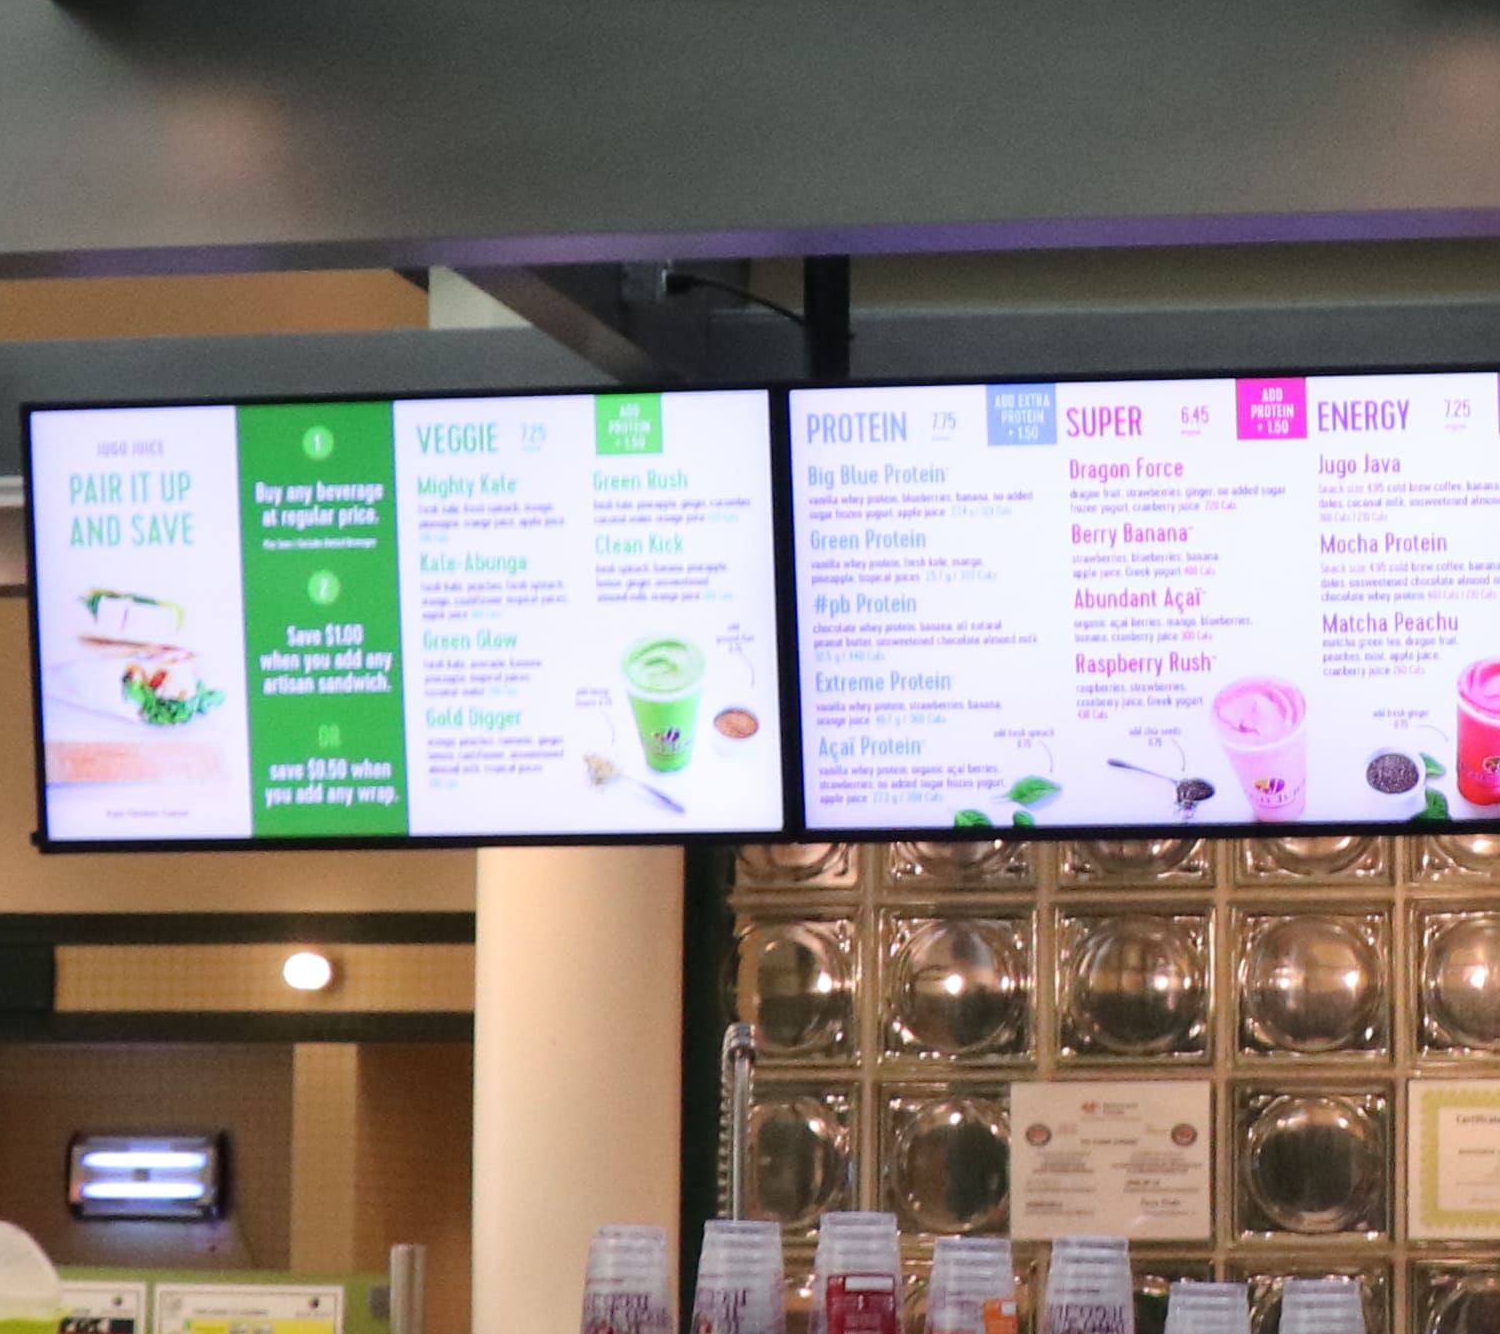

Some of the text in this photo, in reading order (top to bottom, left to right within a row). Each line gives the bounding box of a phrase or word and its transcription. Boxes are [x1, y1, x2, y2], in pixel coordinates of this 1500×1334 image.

[1262, 388, 1283, 402] ADD
[1066, 406, 1209, 437] SUPER 6.45
[1251, 404, 1294, 418] PROTEIN
[1318, 399, 1471, 432] ENERGY 7.25
[416, 424, 498, 455] VEGGIE
[807, 411, 956, 444] PROTEIN 7.75
[808, 463, 946, 490] Big Blue Protein
[1070, 457, 1183, 483] Dragon Force
[1318, 453, 1401, 478] Jugo Java
[70, 471, 191, 504] PAIR IT UP
[418, 475, 516, 499] Mighty Kale
[593, 469, 688, 491] Green Rush
[255, 481, 383, 505] Buy any beverage
[262, 505, 379, 530] at regular price.
[70, 514, 194, 546] AND SAVE
[810, 528, 926, 549] Green Protein
[1071, 523, 1188, 547] Berry Banana
[595, 534, 683, 555] Clean Kick
[1320, 532, 1447, 554] Mocha Protein
[815, 593, 917, 617] #pb Protein
[1075, 588, 1156, 609] Abundant
[1323, 612, 1458, 634] Matcha Peachu
[287, 624, 363, 647] Save $1.00
[423, 629, 517, 650] Green Glow
[260, 649, 392, 674] when you add any
[1076, 652, 1211, 677] Raspberry Rush
[263, 669, 391, 693] artisan sandwich.
[815, 671, 951, 692] Extreme Protein
[426, 708, 521, 731] Gold Digger
[861, 736, 921, 755] Protein
[270, 759, 391, 780] save $0.50 when
[265, 784, 399, 807] you add any wrap.
